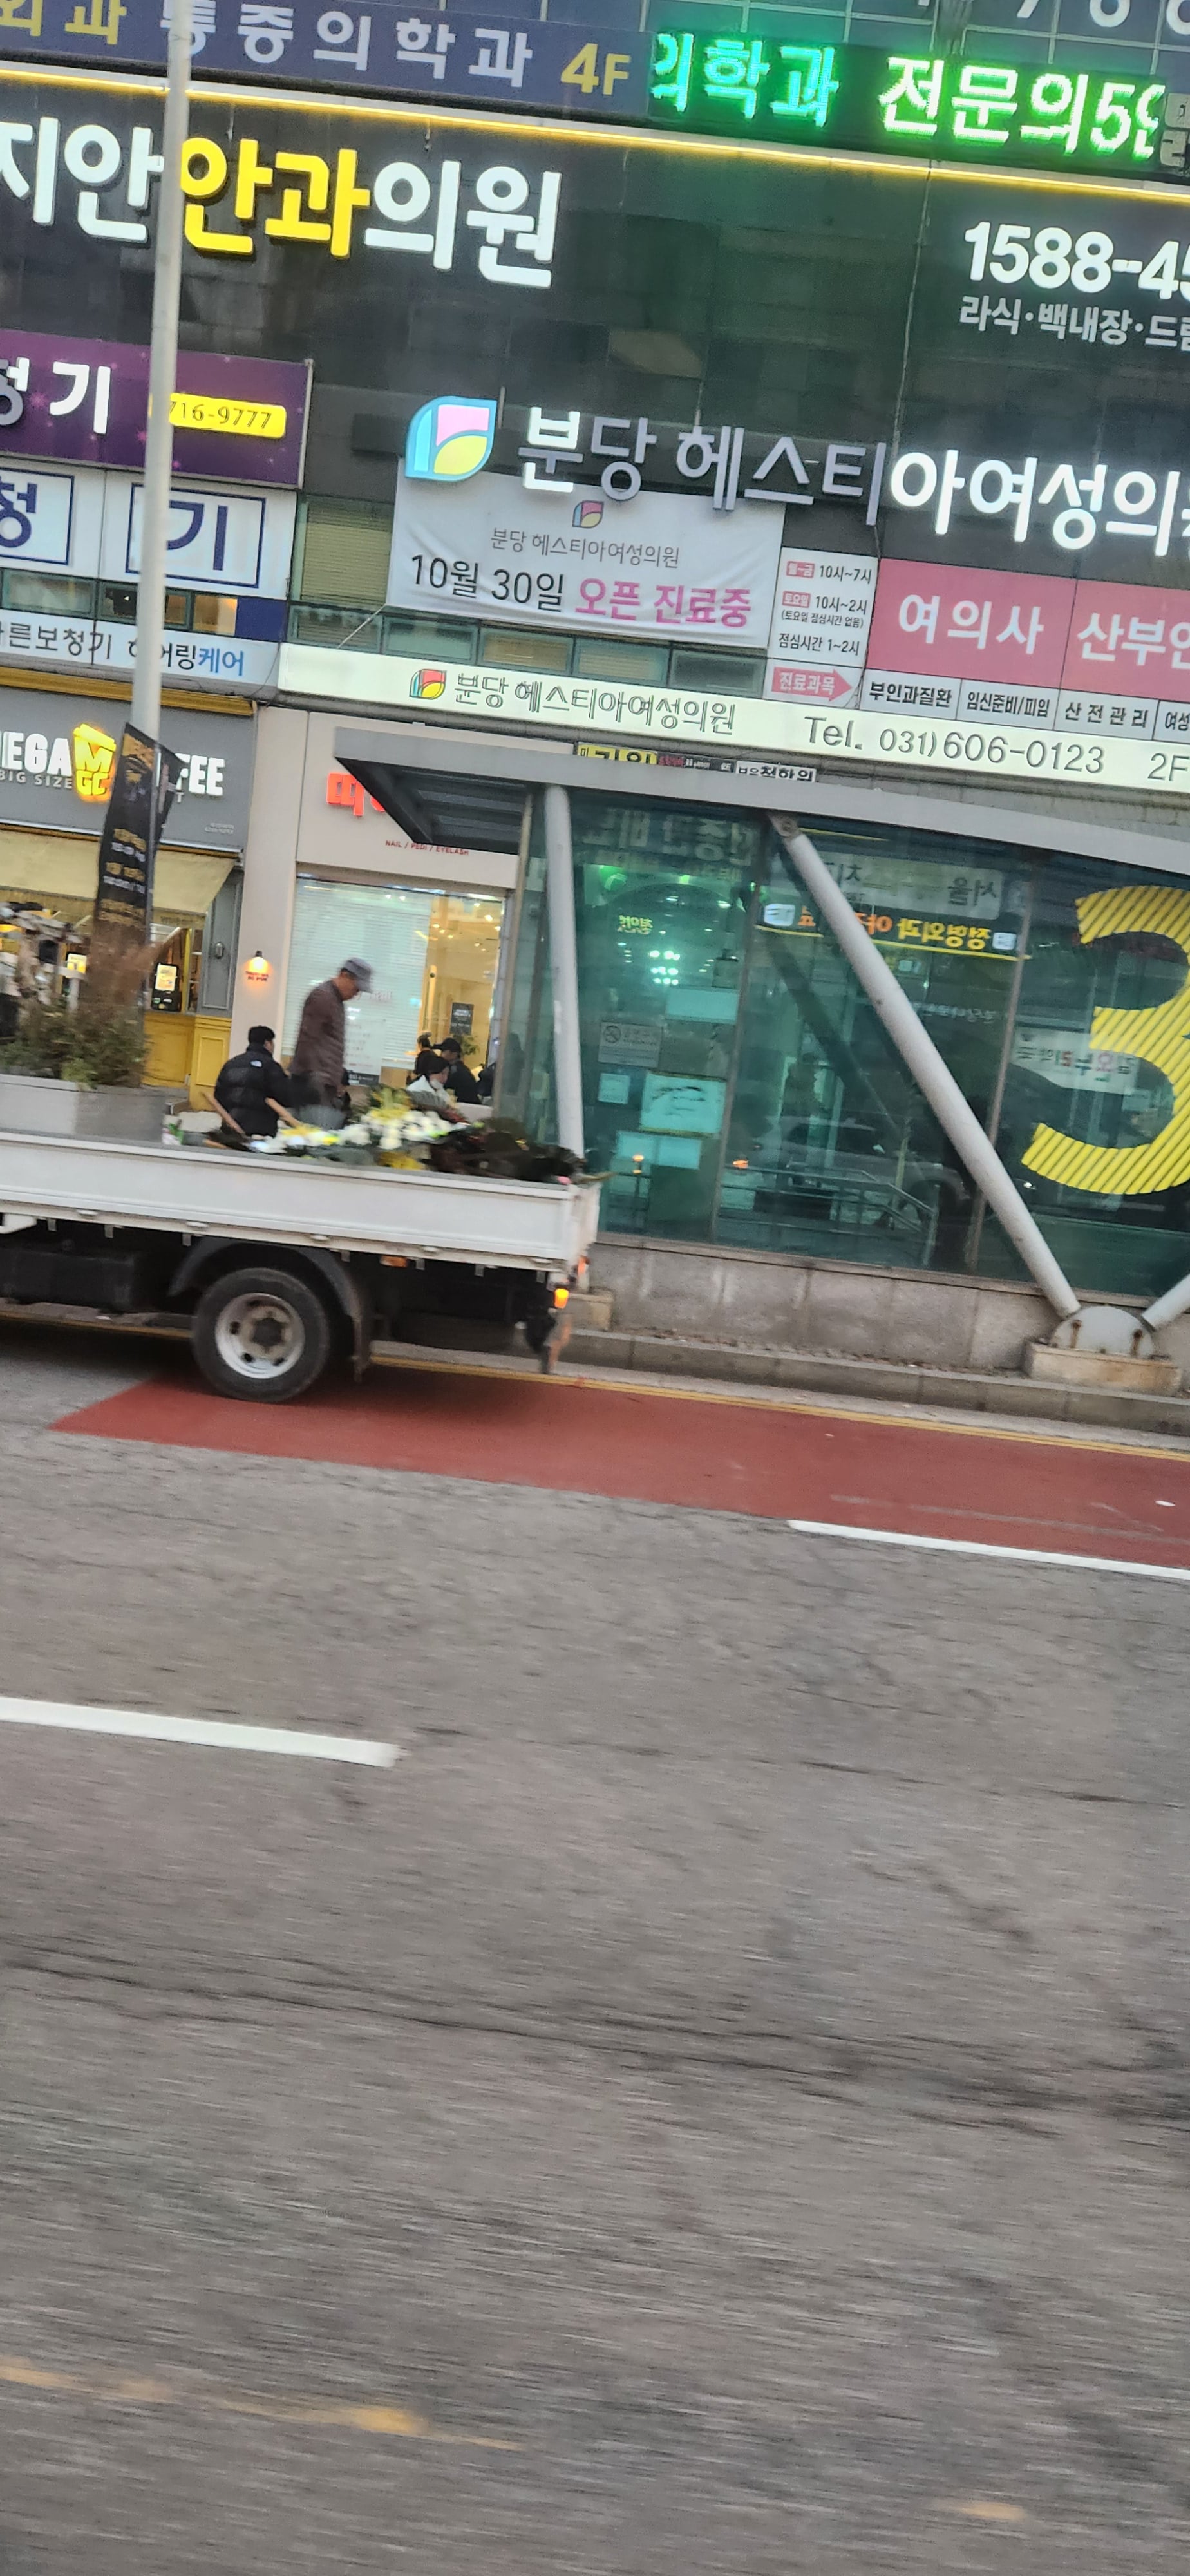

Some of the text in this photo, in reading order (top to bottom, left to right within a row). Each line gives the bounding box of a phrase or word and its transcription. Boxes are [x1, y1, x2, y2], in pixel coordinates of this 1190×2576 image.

[160, 0, 533, 88] 통증의학과
[560, 43, 632, 95] 4F
[518, 406, 1190, 558] 분당 헤스티아여성의
[491, 527, 679, 569] 분당 헤스티아여성의원
[411, 554, 751, 628] 10월 30일 오픈 진료중
[820, 565, 872, 585] 10시~7시
[781, 609, 864, 629] (토요일 점심시간 없음)
[784, 593, 868, 615] 토요일 10시~2시
[898, 594, 1044, 655] 여의사
[0, 620, 245, 676] 른보청기 어링케어
[779, 632, 860, 656] 점심시간 1~2시
[454, 673, 736, 735] 분당 헤스티아여성의원
[779, 672, 835, 695] 진료과목
[869, 681, 952, 709] 부인과질환
[967, 690, 1050, 719] 임신준비/피임
[0, 730, 73, 777] EGA
[804, 716, 862, 750] Tel.
[943, 731, 1105, 774] 606-0123
[1148, 752, 1190, 782] 2F
[35, 775, 73, 790] SIZE
[385, 840, 469, 856] NAIL PEDI EYELASH
[1021, 885, 1190, 1195] 3
